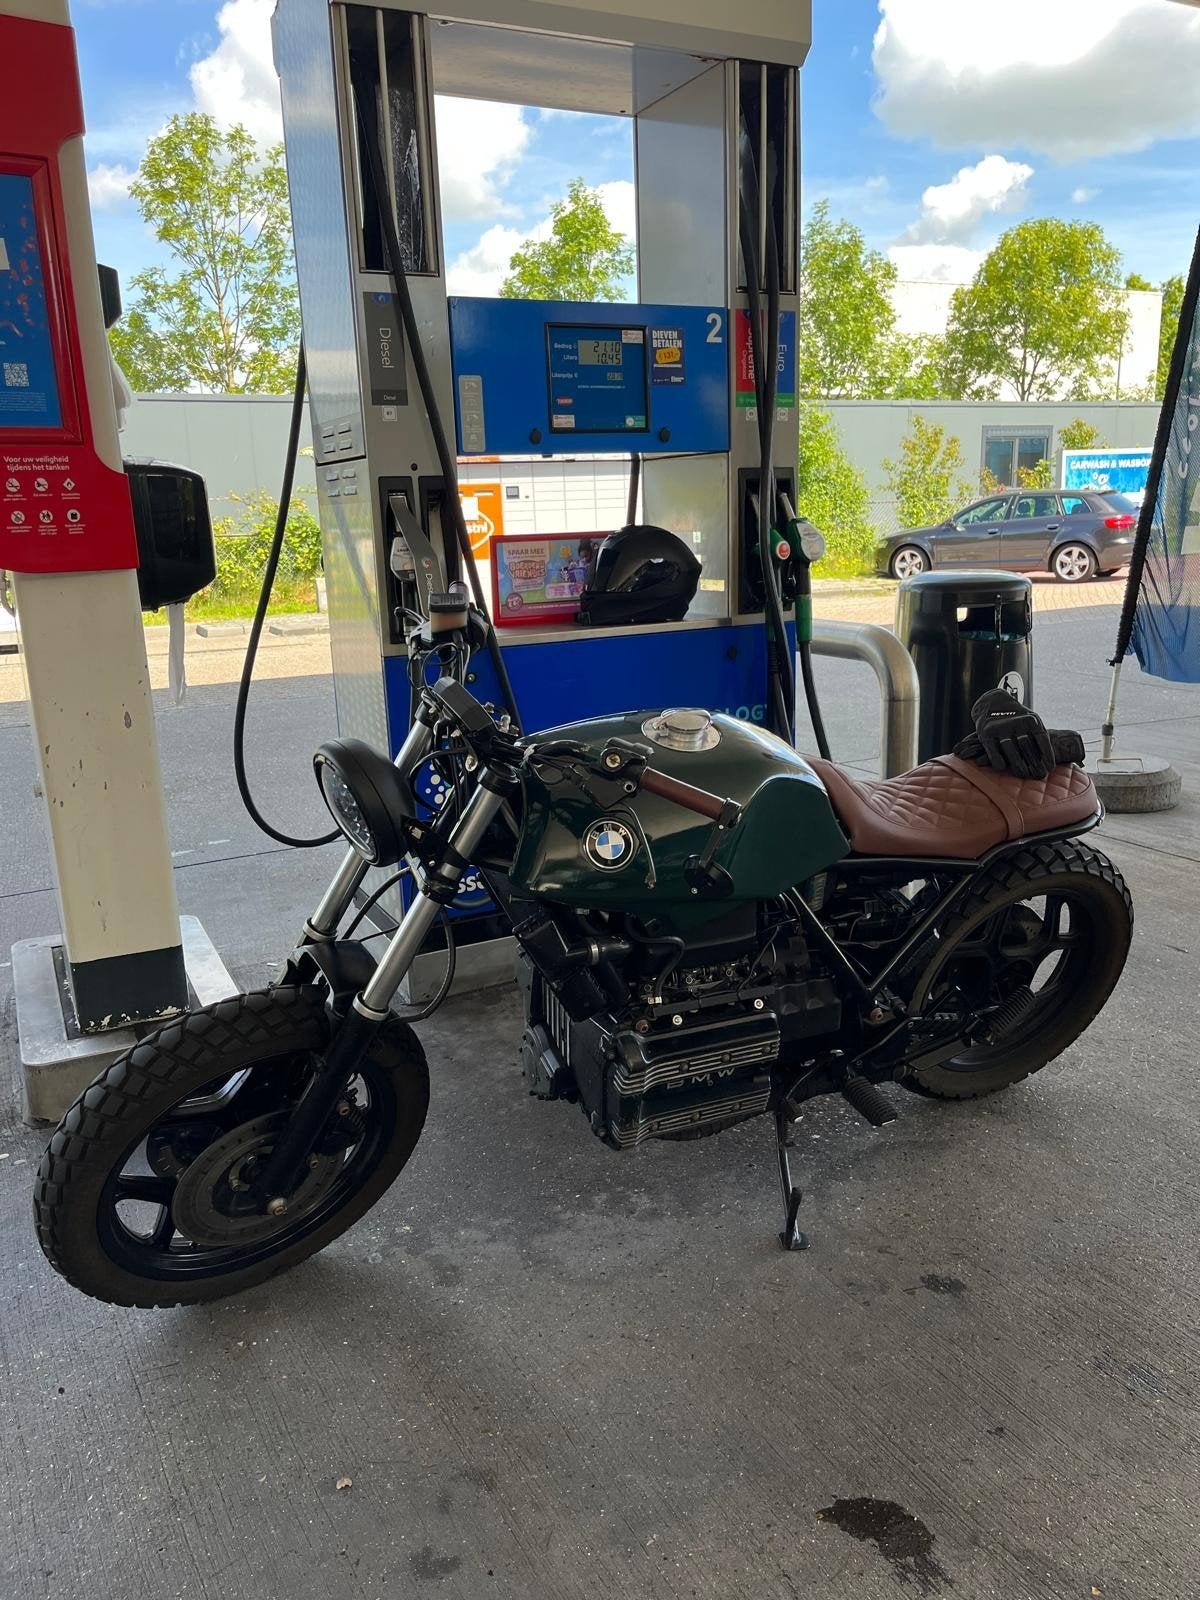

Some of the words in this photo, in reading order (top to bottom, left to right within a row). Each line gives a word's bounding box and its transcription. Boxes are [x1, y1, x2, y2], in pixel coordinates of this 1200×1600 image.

[706, 312, 723, 343] 2
[652, 330, 678, 339] DIEVEN
[379, 327, 395, 368] Diesel
[652, 339, 682, 348] BETALEN
[777, 344, 787, 372] Euro
[35, 456, 69, 464] veiligheid
[1070, 459, 1110, 470] CARWASH
[7, 464, 31, 472] tijdens
[590, 824, 627, 840] BMW
[667, 1068, 735, 1090] BMW
